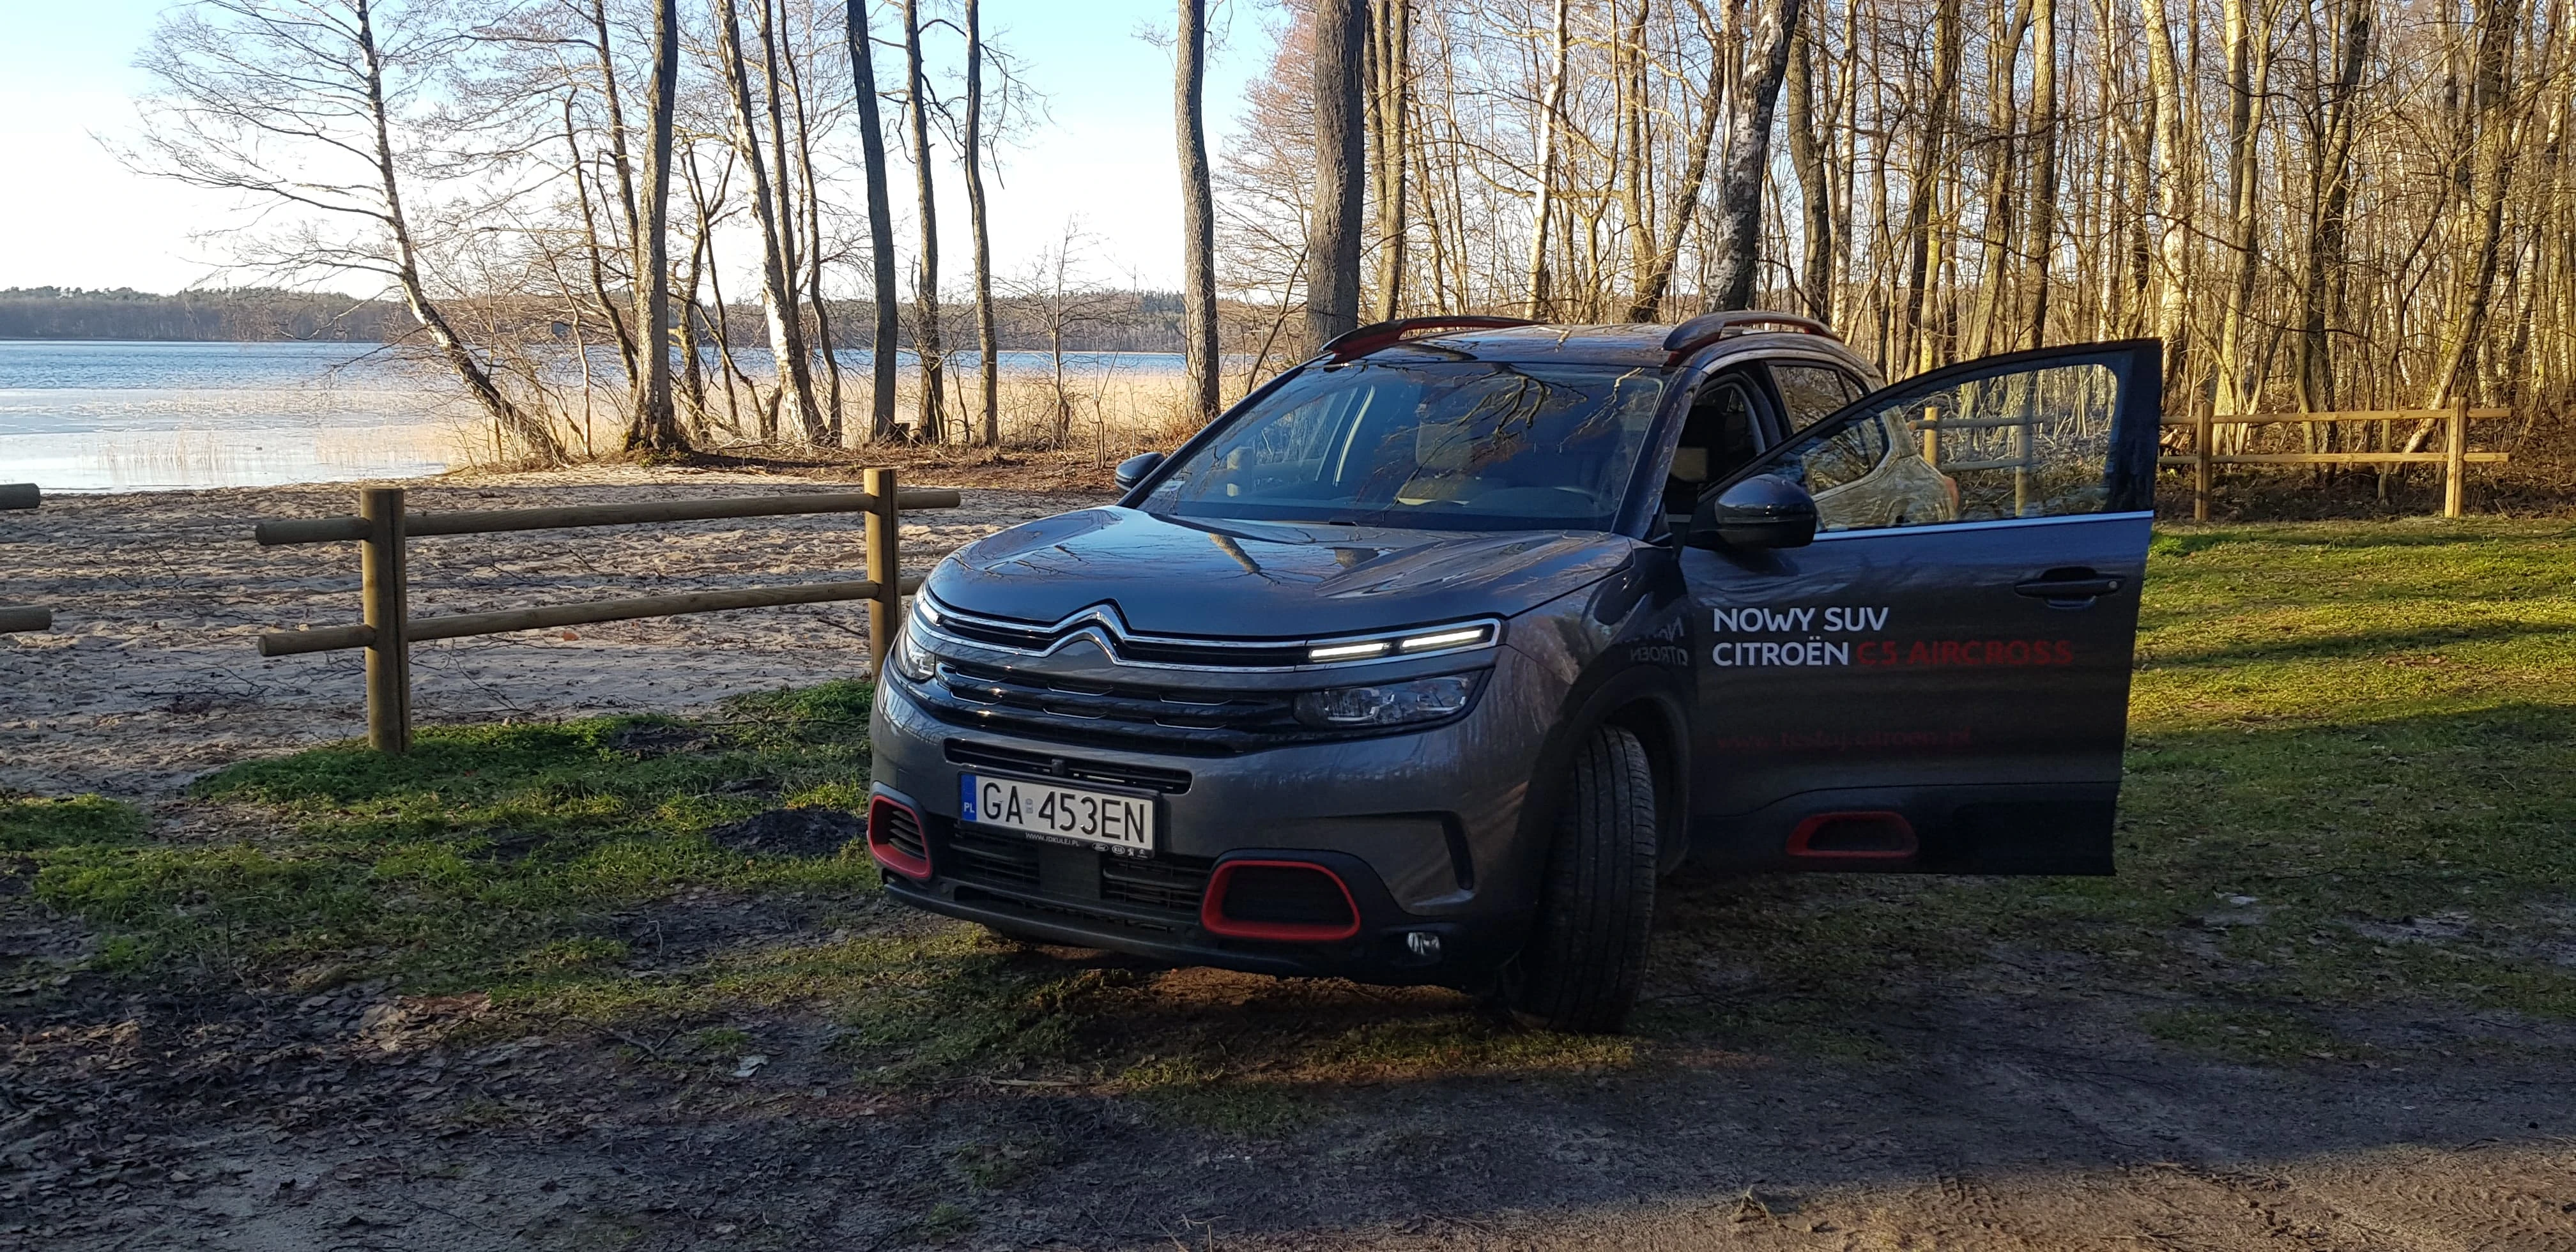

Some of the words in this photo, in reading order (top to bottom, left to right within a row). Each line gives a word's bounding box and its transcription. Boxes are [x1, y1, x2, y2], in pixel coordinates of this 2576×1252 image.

[1713, 607, 1816, 632] NOWY
[1823, 606, 1889, 632] SUV
[1712, 636, 1849, 666] CITROËN
[1857, 640, 1898, 666] C5
[1907, 639, 2074, 666] AIRCROSS
[963, 802, 975, 814] PL
[983, 782, 1023, 825] GA
[1038, 791, 1145, 843] 453EN
